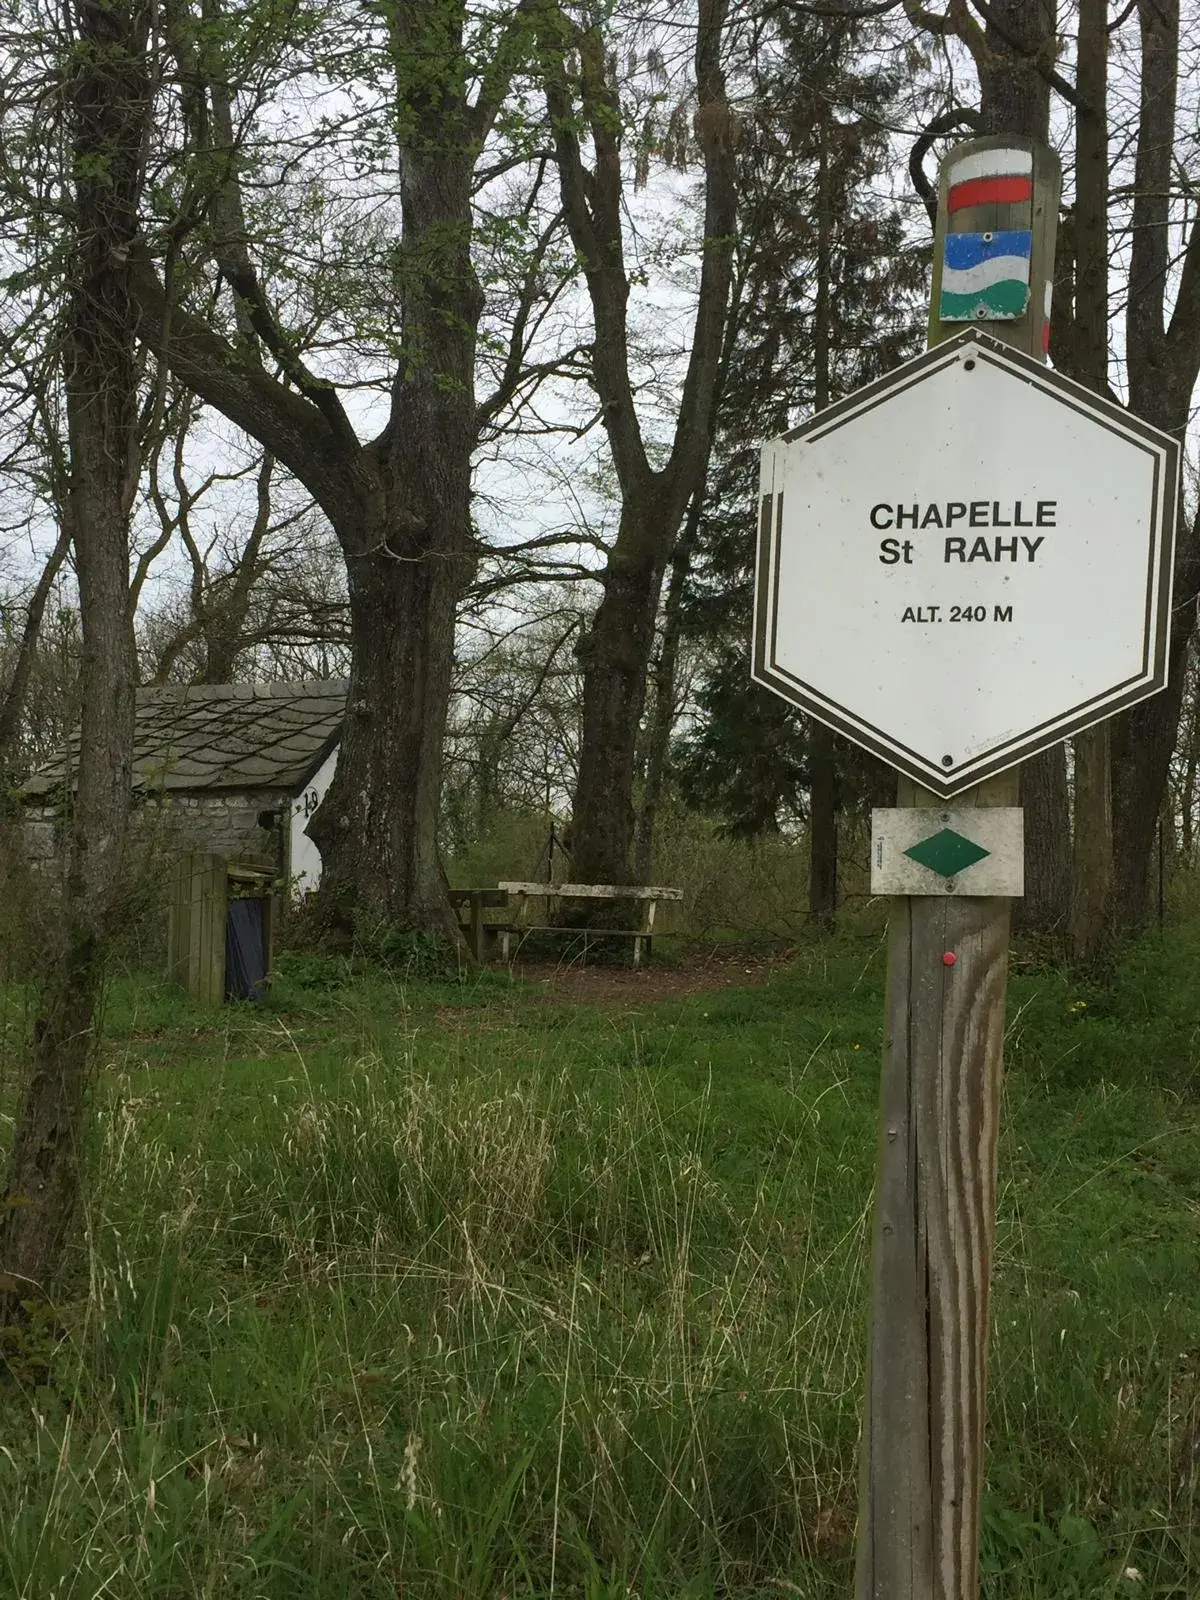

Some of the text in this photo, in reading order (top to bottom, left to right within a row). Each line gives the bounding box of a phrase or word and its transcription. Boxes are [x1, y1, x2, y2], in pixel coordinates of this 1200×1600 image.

[869, 501, 1057, 529] CHAPELLE
[879, 536, 1045, 564] St RAHY
[901, 605, 1013, 623] ALT. 240 M
